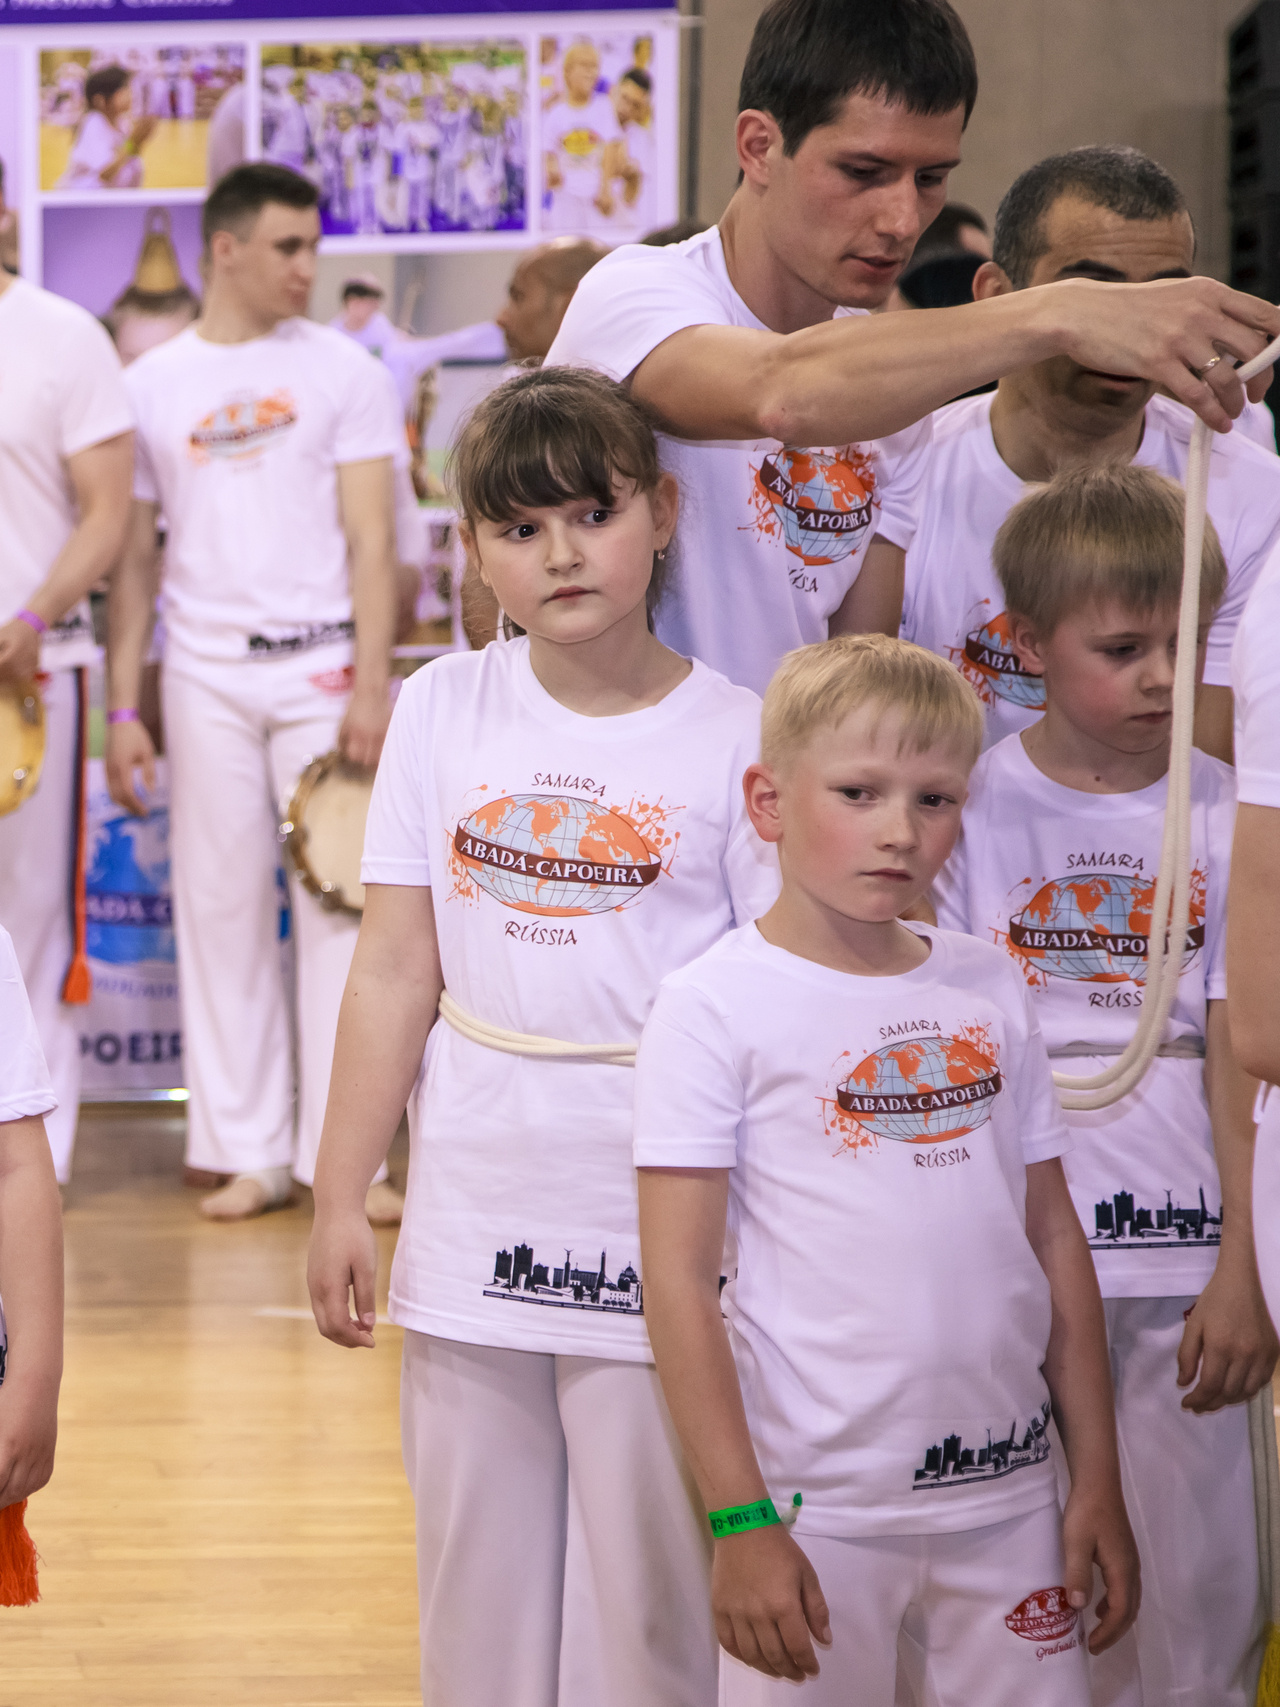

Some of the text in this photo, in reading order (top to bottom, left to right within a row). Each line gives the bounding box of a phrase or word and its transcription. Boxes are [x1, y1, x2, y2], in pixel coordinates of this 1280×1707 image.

[531, 772, 607, 797] SAMARA
[460, 838, 644, 884] ABADÁ-CAPOEIRA
[1066, 851, 1144, 871] SAMARA
[504, 920, 578, 946] RÚSSIA
[1088, 986, 1144, 1009] RÚSS
[879, 1019, 942, 1040] SAMARA
[849, 1080, 996, 1112] ABADÁ-CAPOEIRA
[913, 1147, 971, 1168] RÚSSIA
